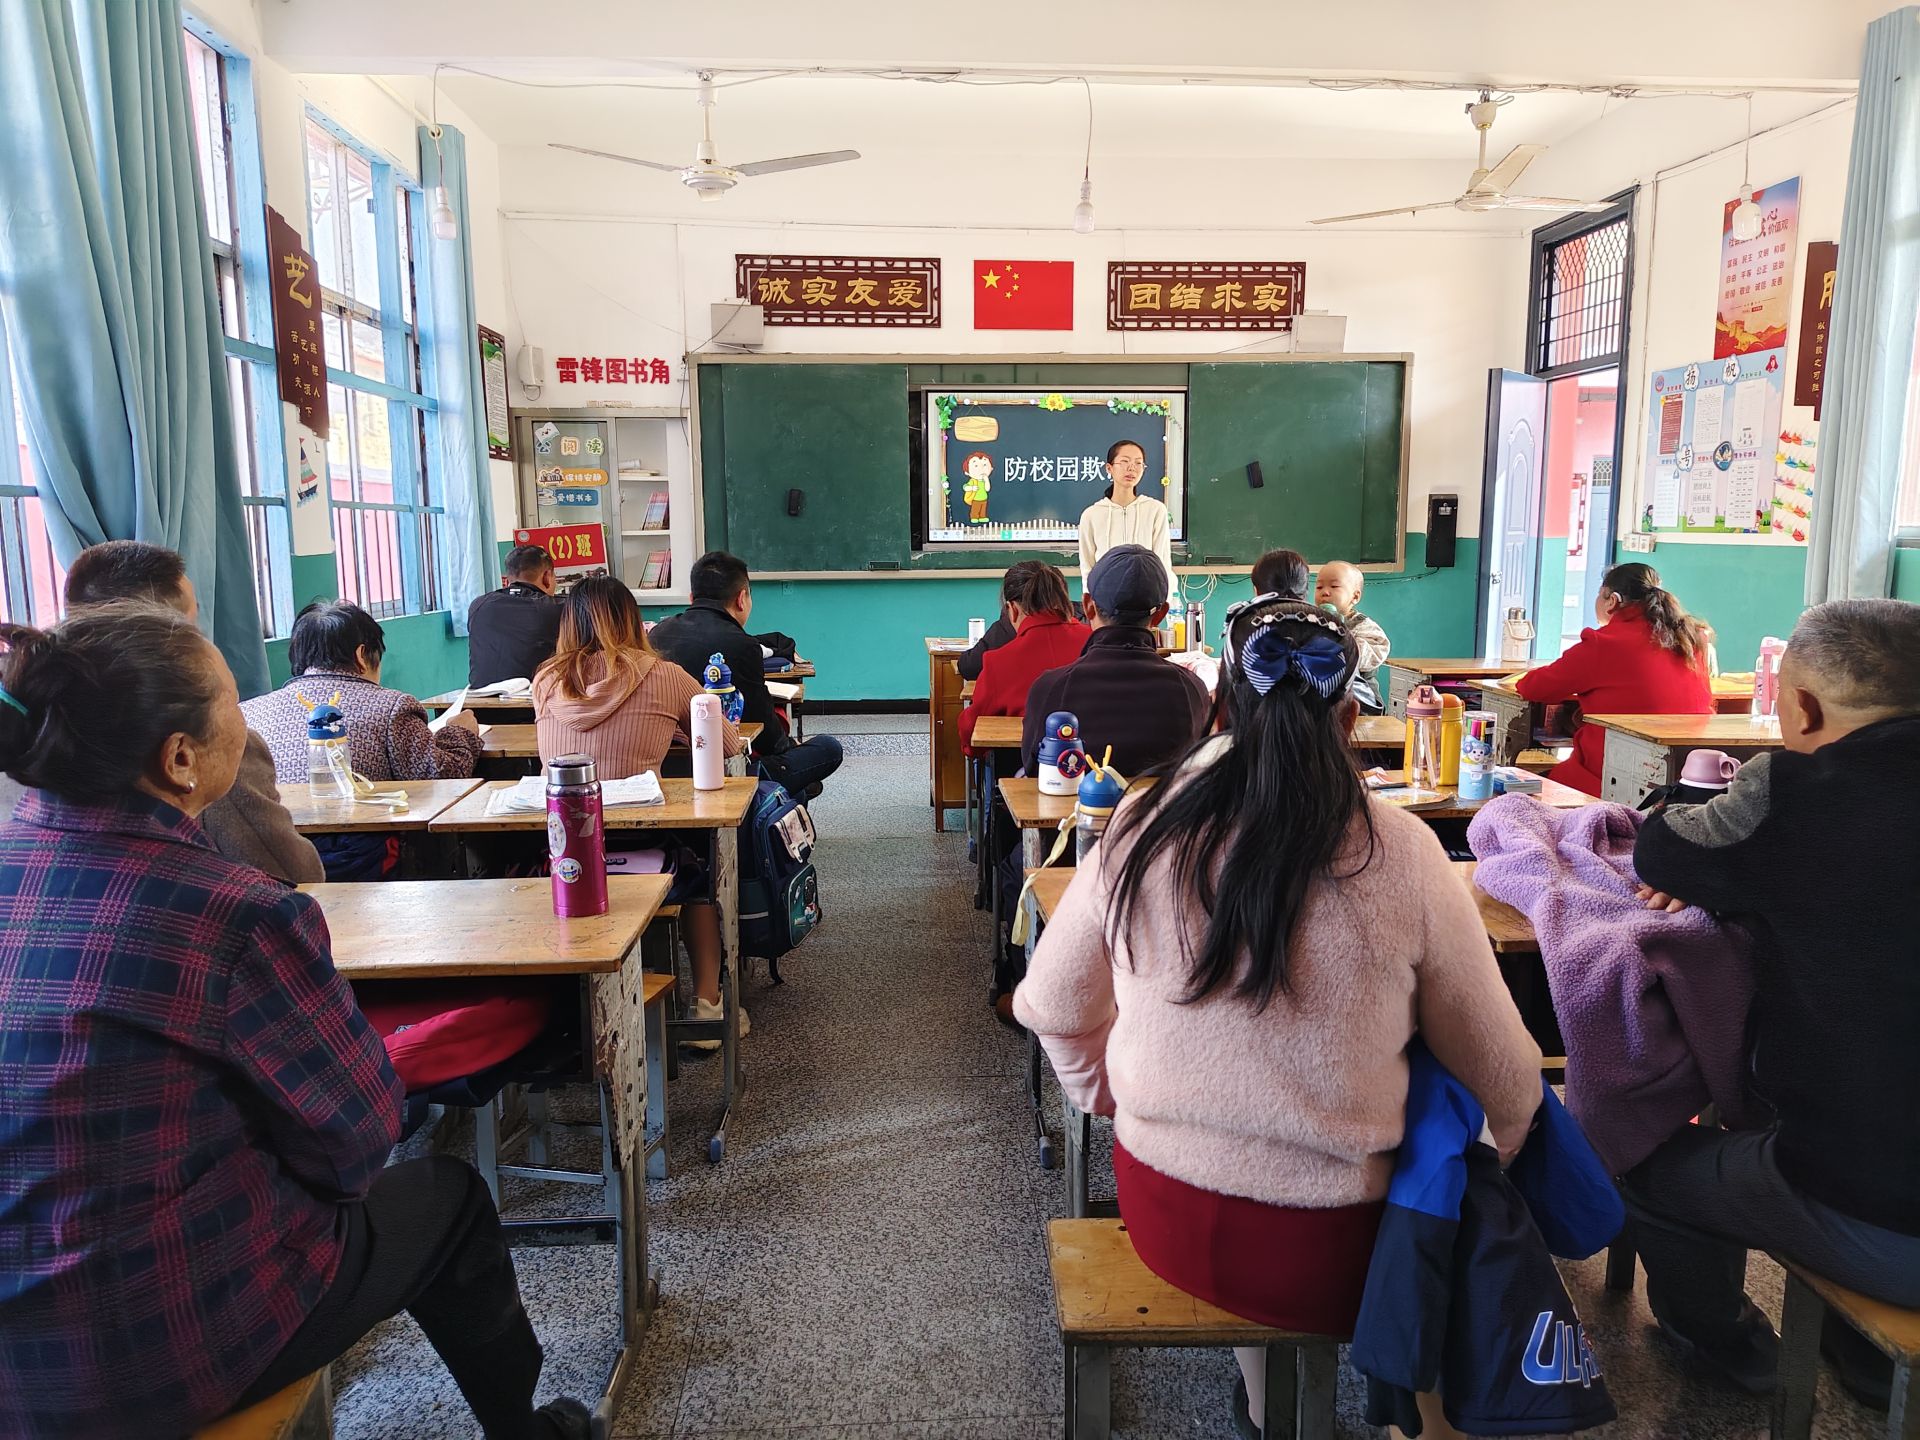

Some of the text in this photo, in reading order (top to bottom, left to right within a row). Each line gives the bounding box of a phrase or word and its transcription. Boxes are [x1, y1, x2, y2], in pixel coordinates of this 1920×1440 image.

[284, 252, 312, 309] 艺
[757, 276, 924, 309] 诚实友爱
[1129, 281, 1288, 314] 团结求实
[556, 357, 670, 384] 雷锋图书角
[1726, 363, 1736, 378] 帆
[1004, 456, 1114, 482] 防校园欺
[539, 534, 592, 560] (2)班
